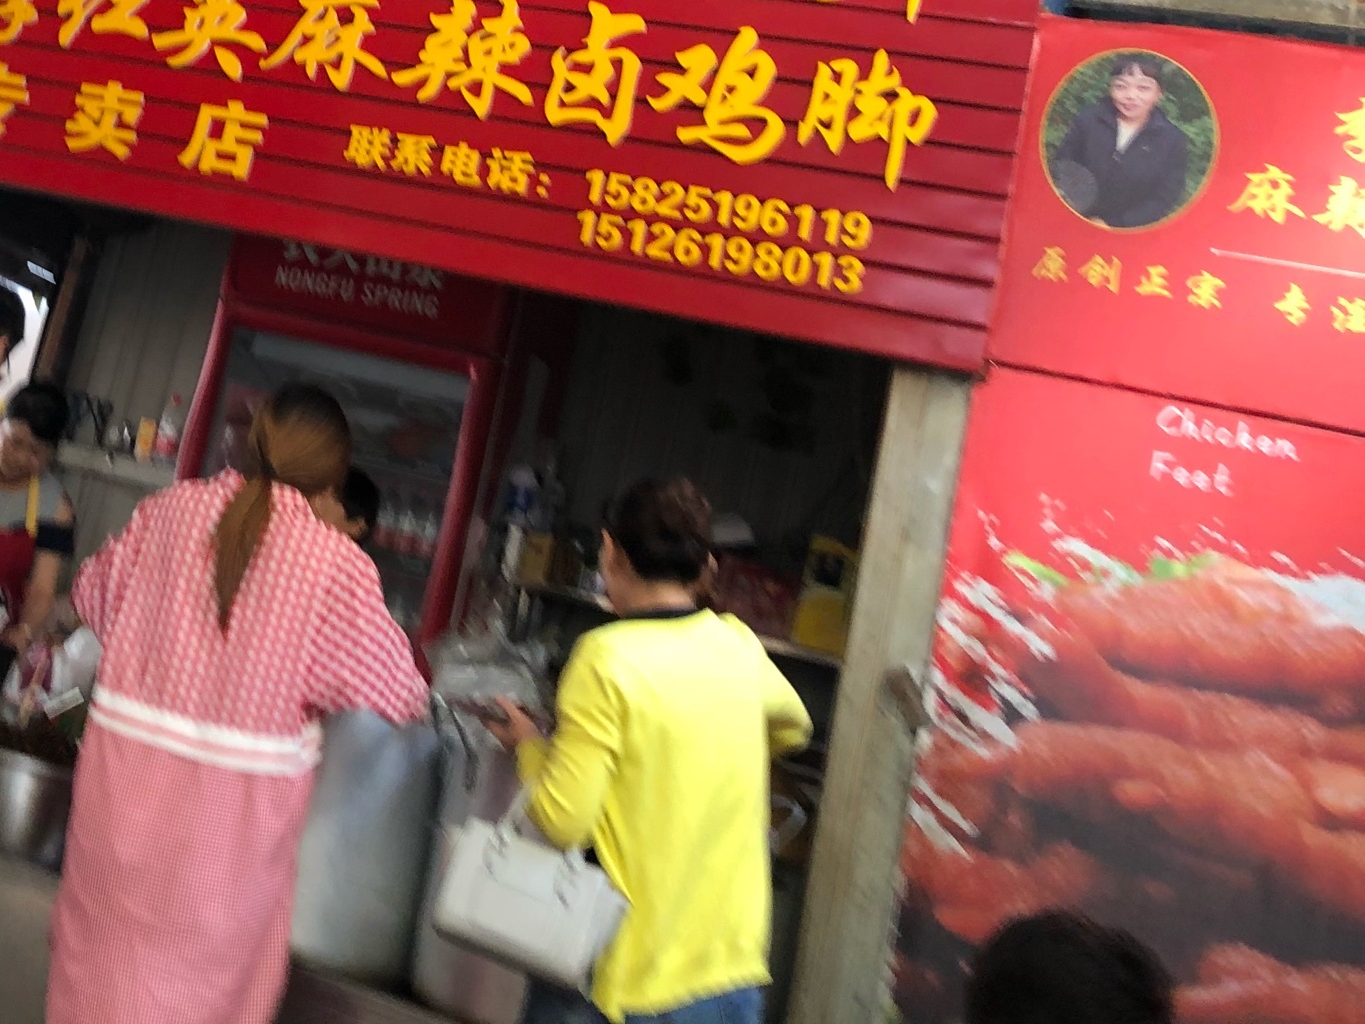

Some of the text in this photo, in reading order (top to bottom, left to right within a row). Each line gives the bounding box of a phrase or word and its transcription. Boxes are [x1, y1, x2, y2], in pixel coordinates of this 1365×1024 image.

[584, 168, 873, 250] 15825196119
[577, 208, 866, 295] 15126198013
[1031, 245, 1228, 311] 原创正宗
[274, 263, 356, 304] NONGFU
[360, 280, 440, 321] SPRING
[1155, 404, 1301, 463] Chicken
